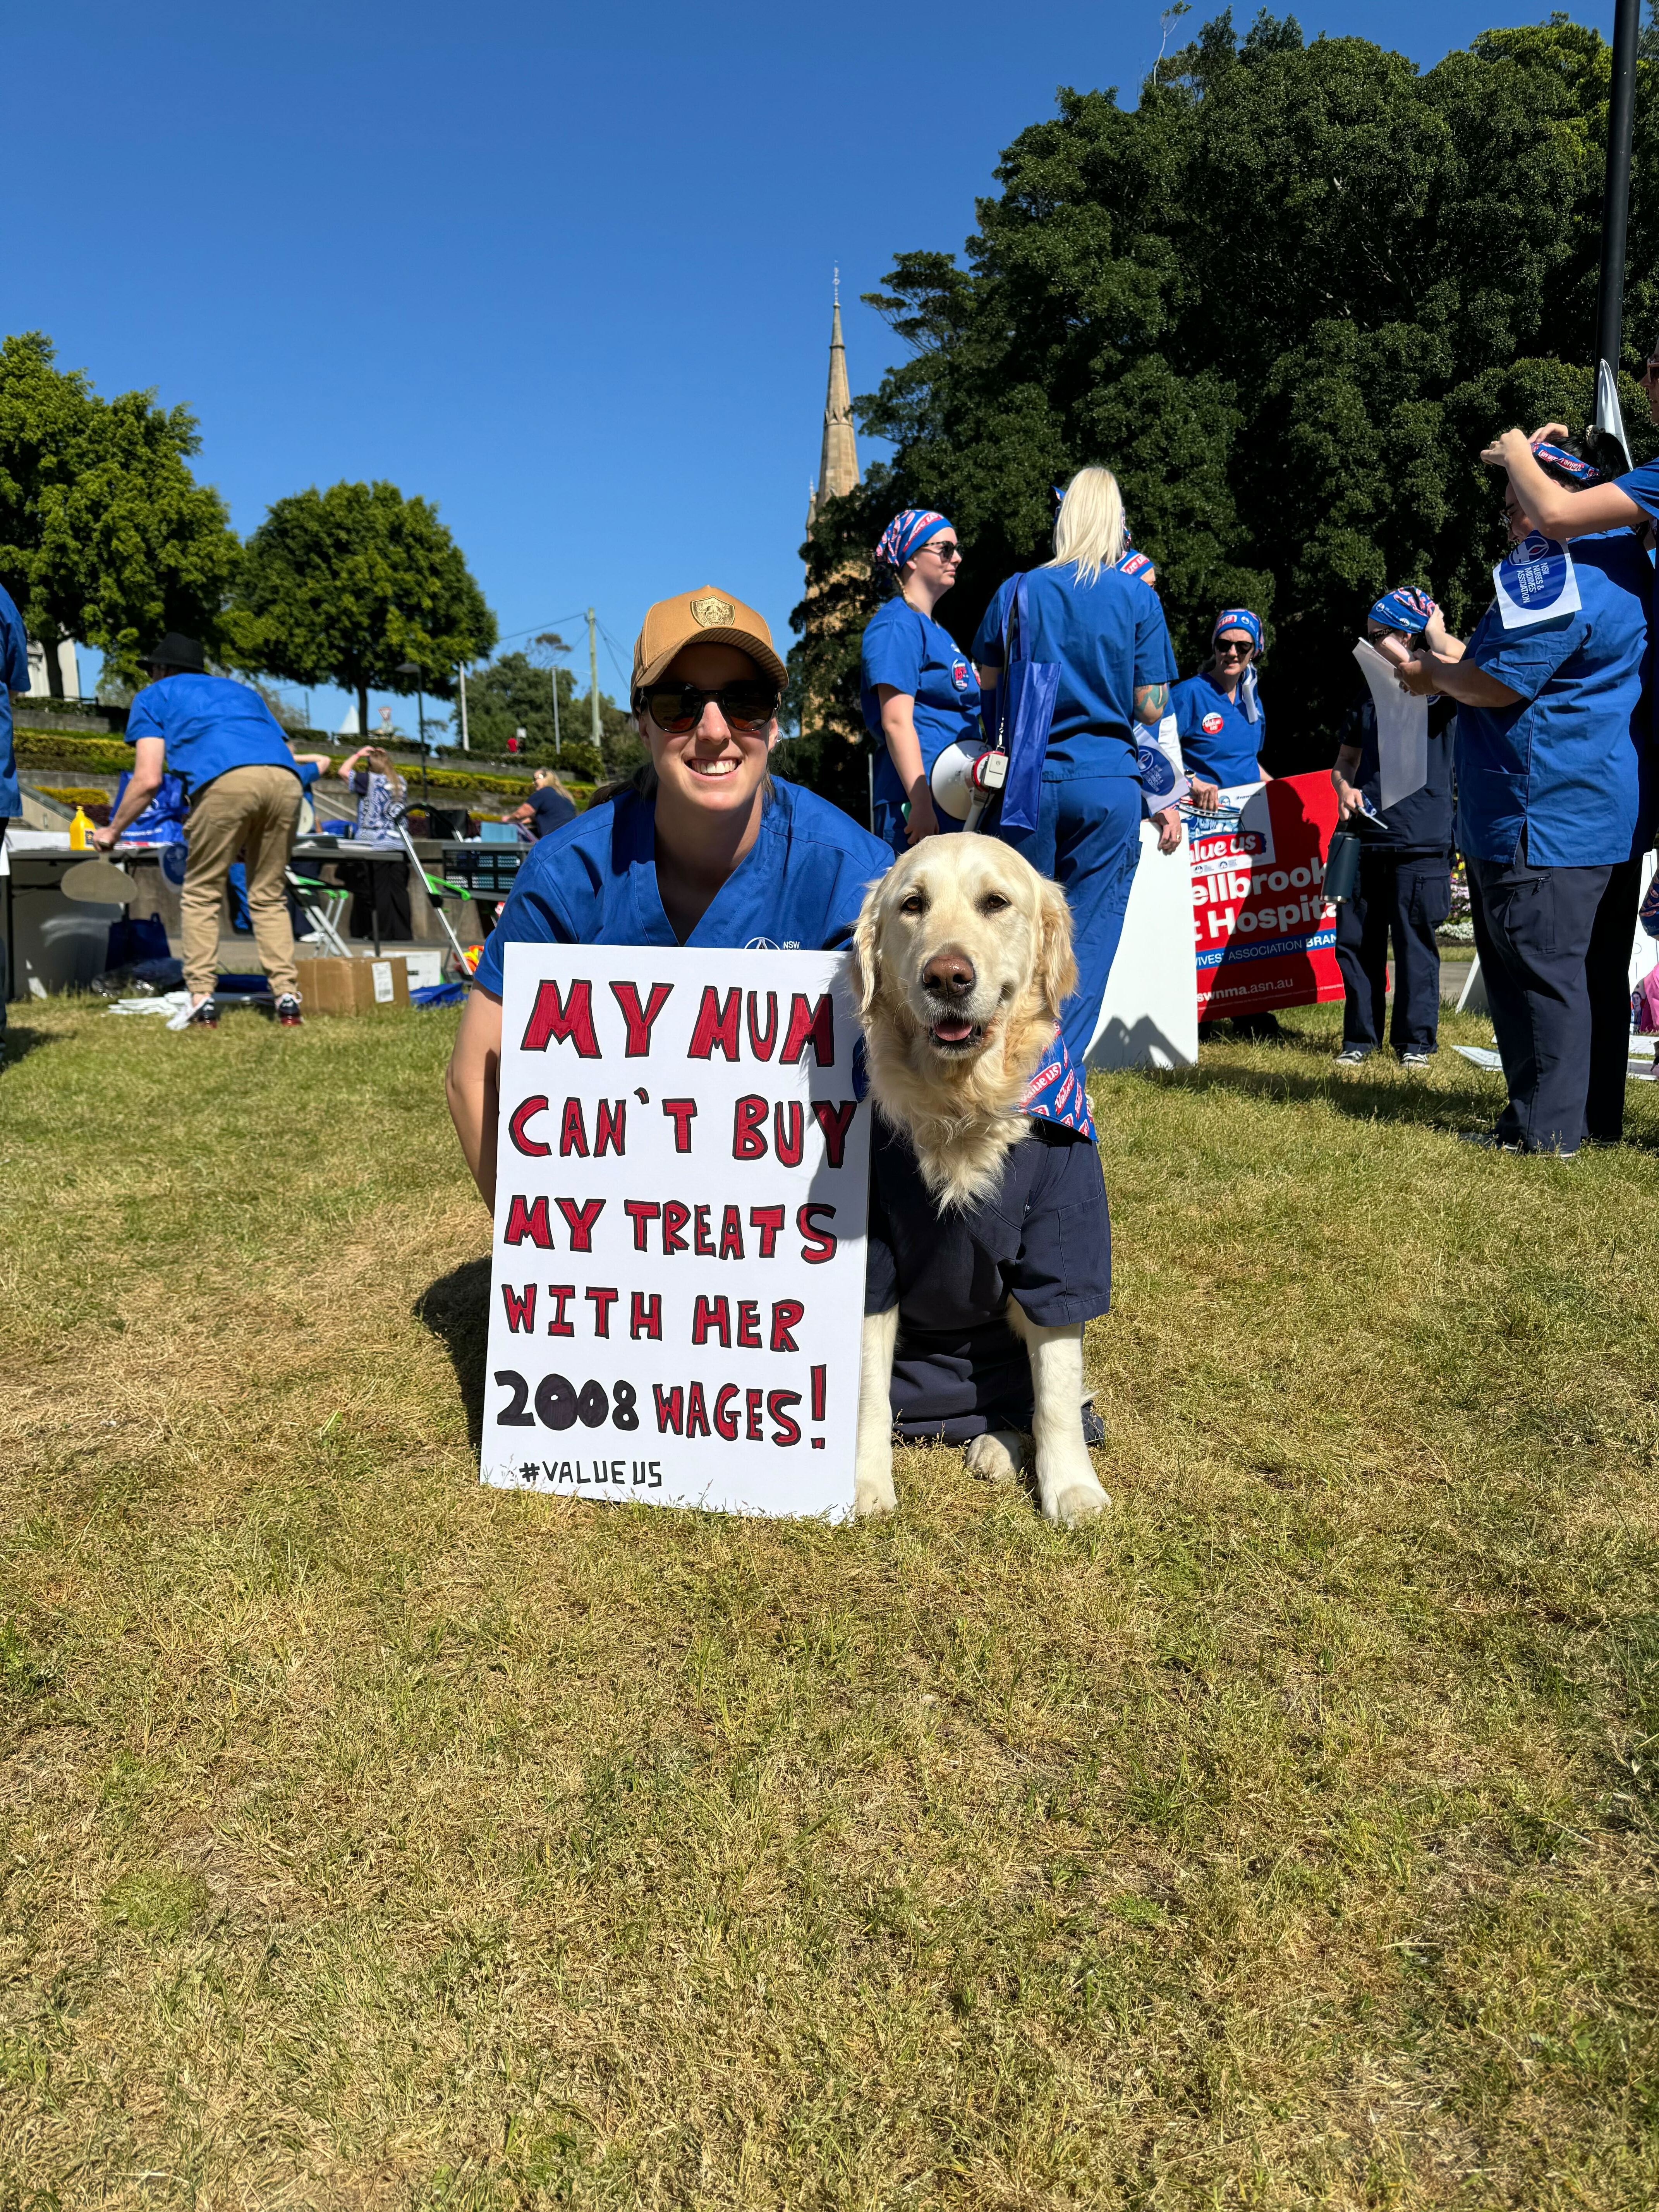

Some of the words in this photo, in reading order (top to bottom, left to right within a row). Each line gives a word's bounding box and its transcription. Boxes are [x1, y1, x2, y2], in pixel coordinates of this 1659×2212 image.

[1540, 562, 1550, 575] NSW
[1231, 835, 1256, 854] us
[1228, 940, 1302, 961] ASSOCIATION
[520, 979, 674, 1059] MY
[687, 986, 835, 1067] MUM
[1046, 1066, 1059, 1081] us
[508, 1087, 697, 1158] CAN'T
[732, 1094, 857, 1169] BUY
[504, 1195, 606, 1252] MY
[624, 1199, 837, 1264] TREATS
[501, 1283, 662, 1341] WITH
[692, 1295, 804, 1352] HER
[494, 1370, 639, 1431] 2008
[653, 1364, 826, 1449] WAGES!
